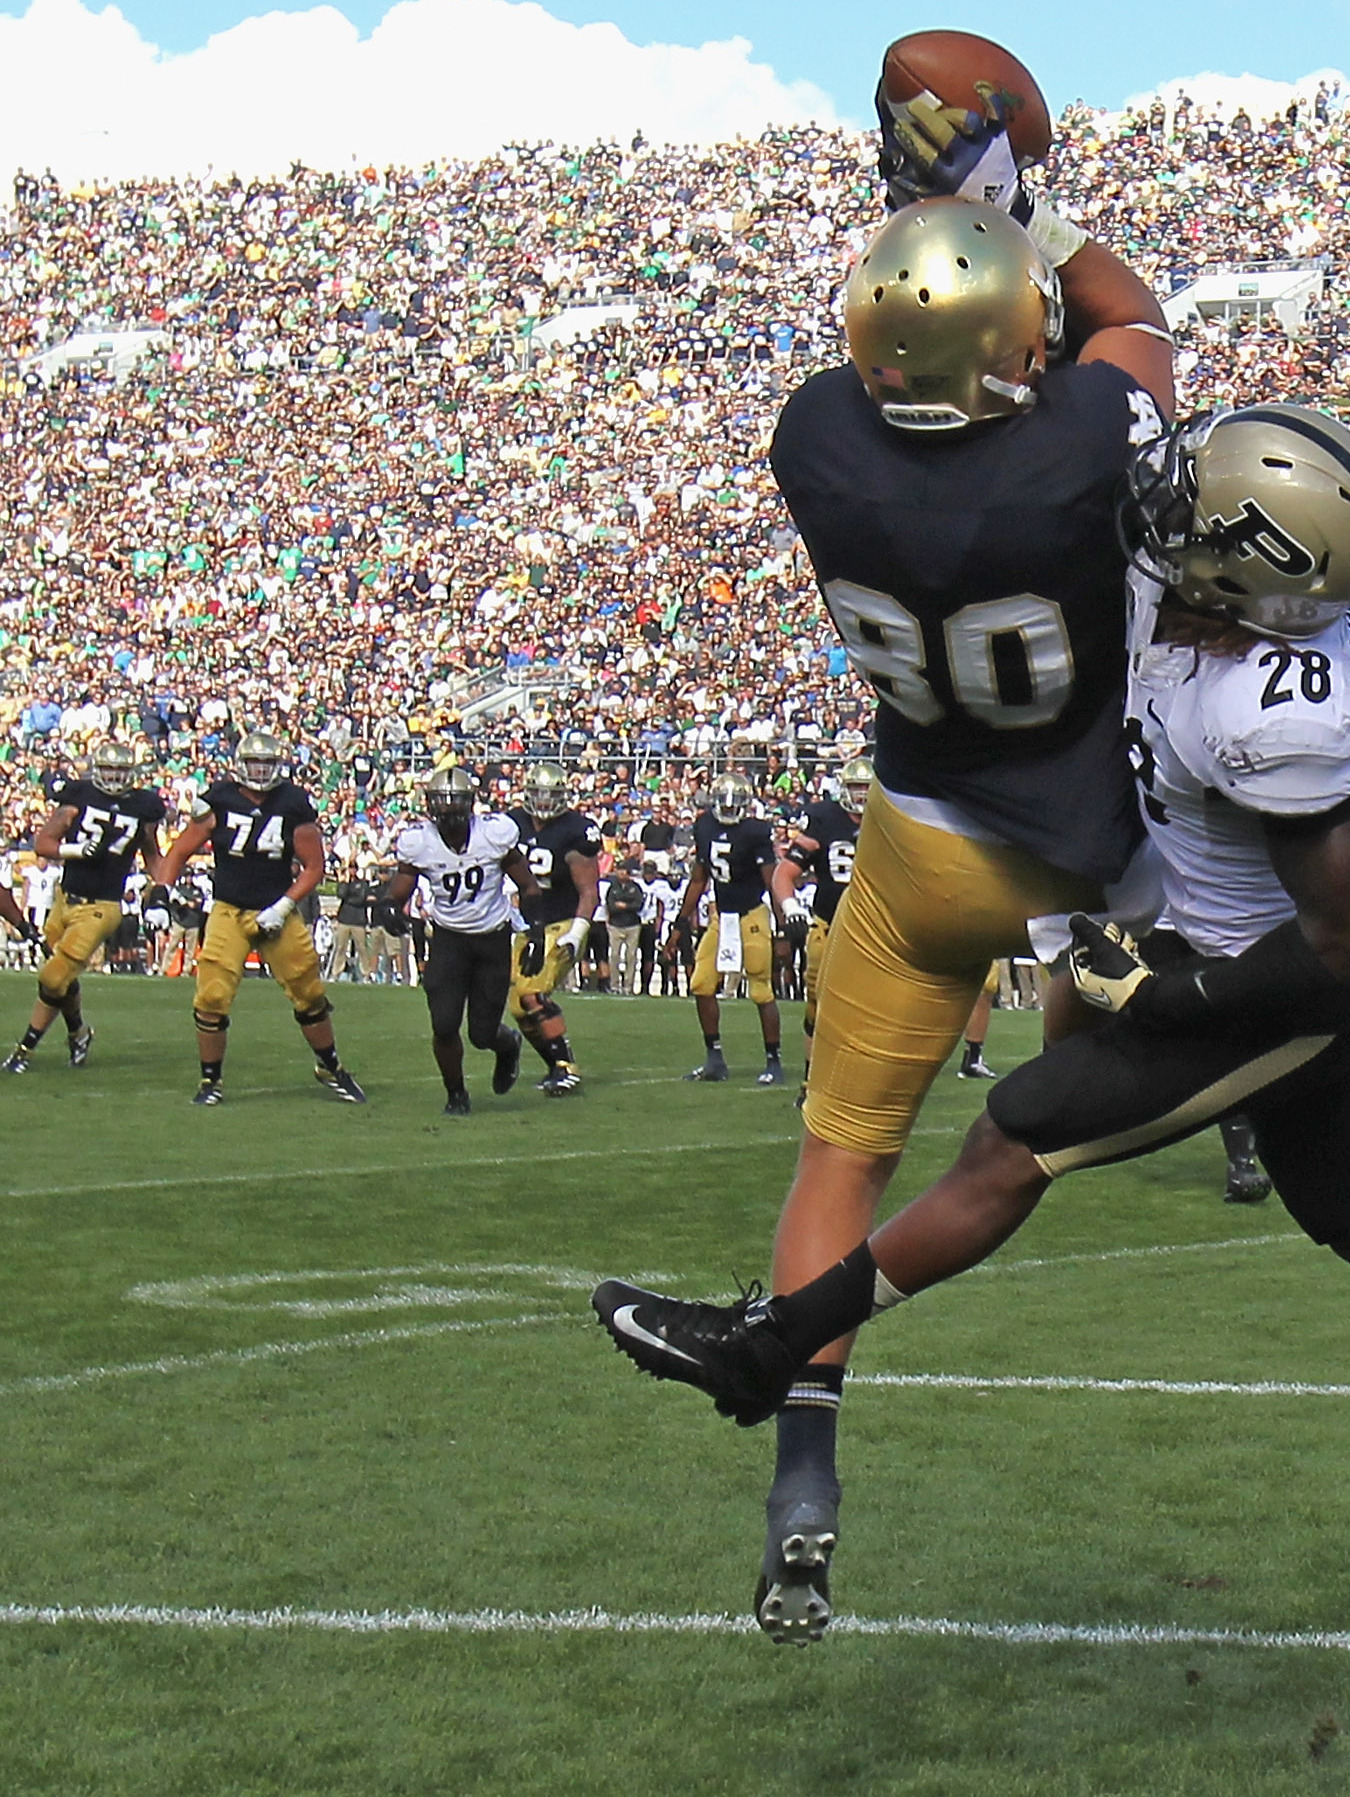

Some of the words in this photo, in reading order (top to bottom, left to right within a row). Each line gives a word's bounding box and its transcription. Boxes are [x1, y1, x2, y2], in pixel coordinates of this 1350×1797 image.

[824, 578, 1076, 730] 80
[1258, 650, 1332, 710] 28
[77, 805, 139, 856] 57
[226, 811, 285, 859] 74
[442, 865, 484, 906] 99
[517, 842, 554, 889] 2
[710, 841, 732, 884] 5
[828, 840, 856, 884] 6
